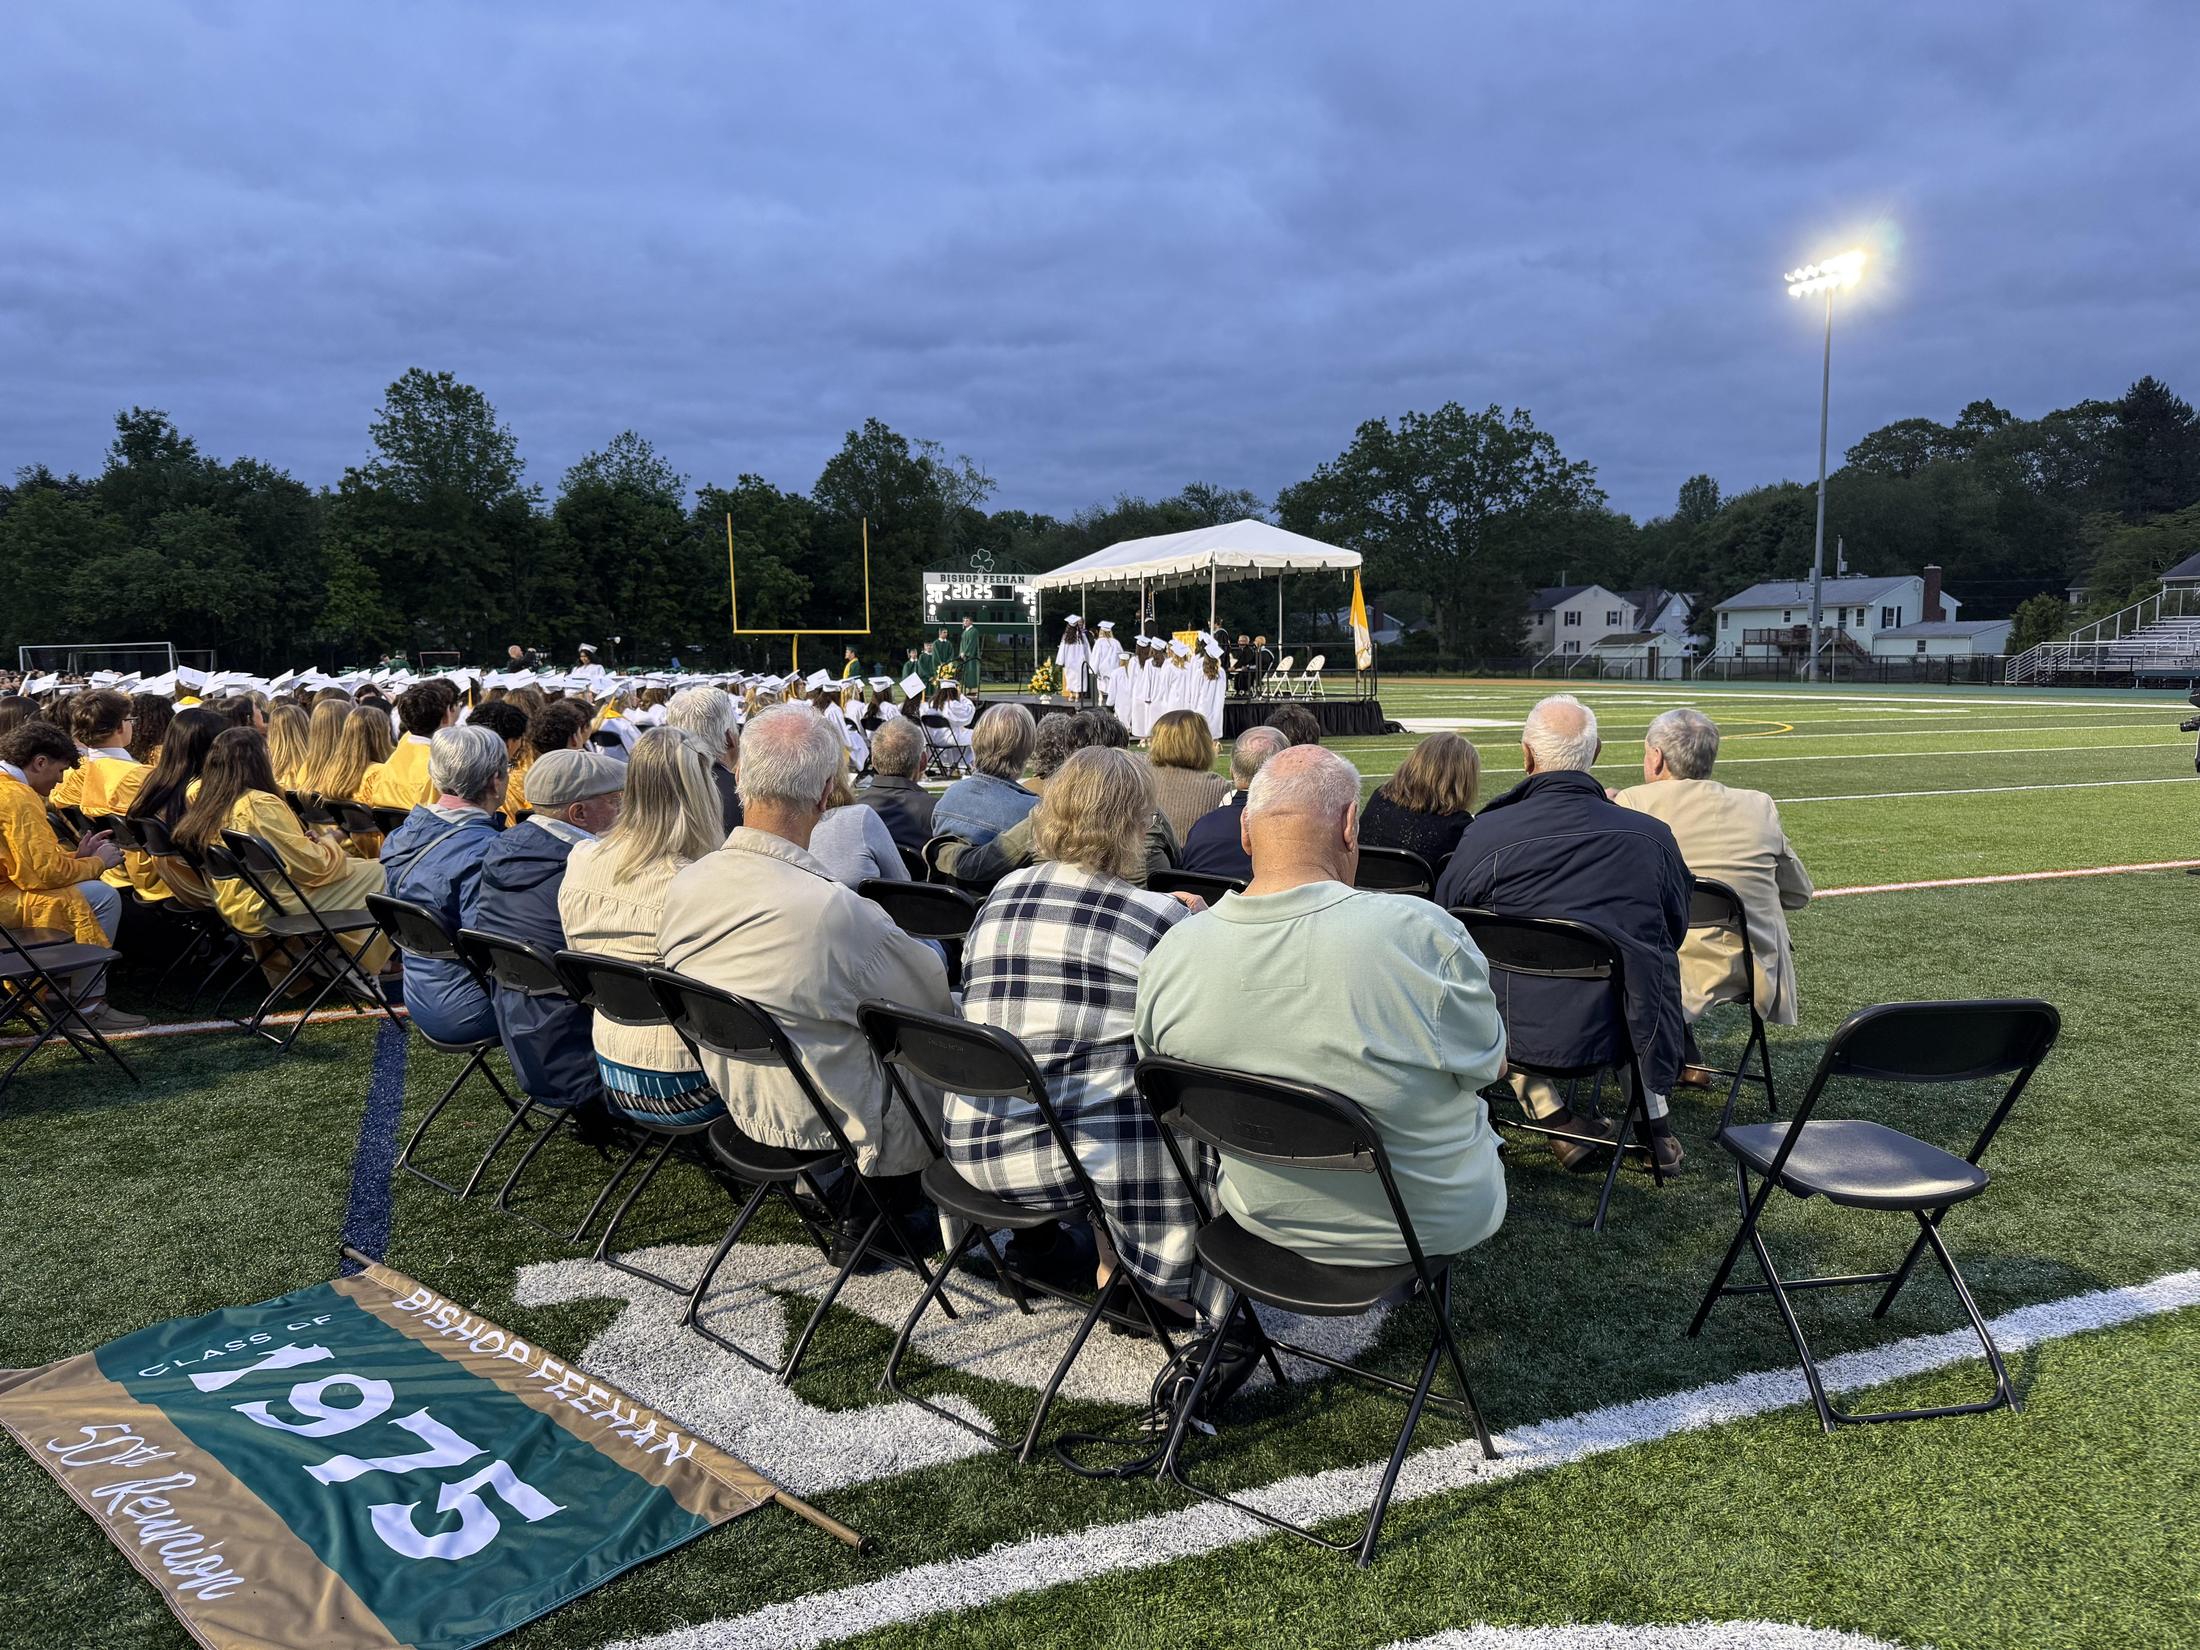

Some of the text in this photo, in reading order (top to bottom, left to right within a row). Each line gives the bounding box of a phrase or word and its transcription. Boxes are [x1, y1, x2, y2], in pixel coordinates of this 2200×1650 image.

[940, 574, 1025, 584] BISHOP FEEHAN
[952, 584, 993, 599] 2025
[138, 1314, 332, 1377] CLASS OF
[392, 1287, 698, 1467] BISHOP FEEHAN
[188, 1342, 568, 1560] 1975
[91, 1471, 245, 1600] Reunion
